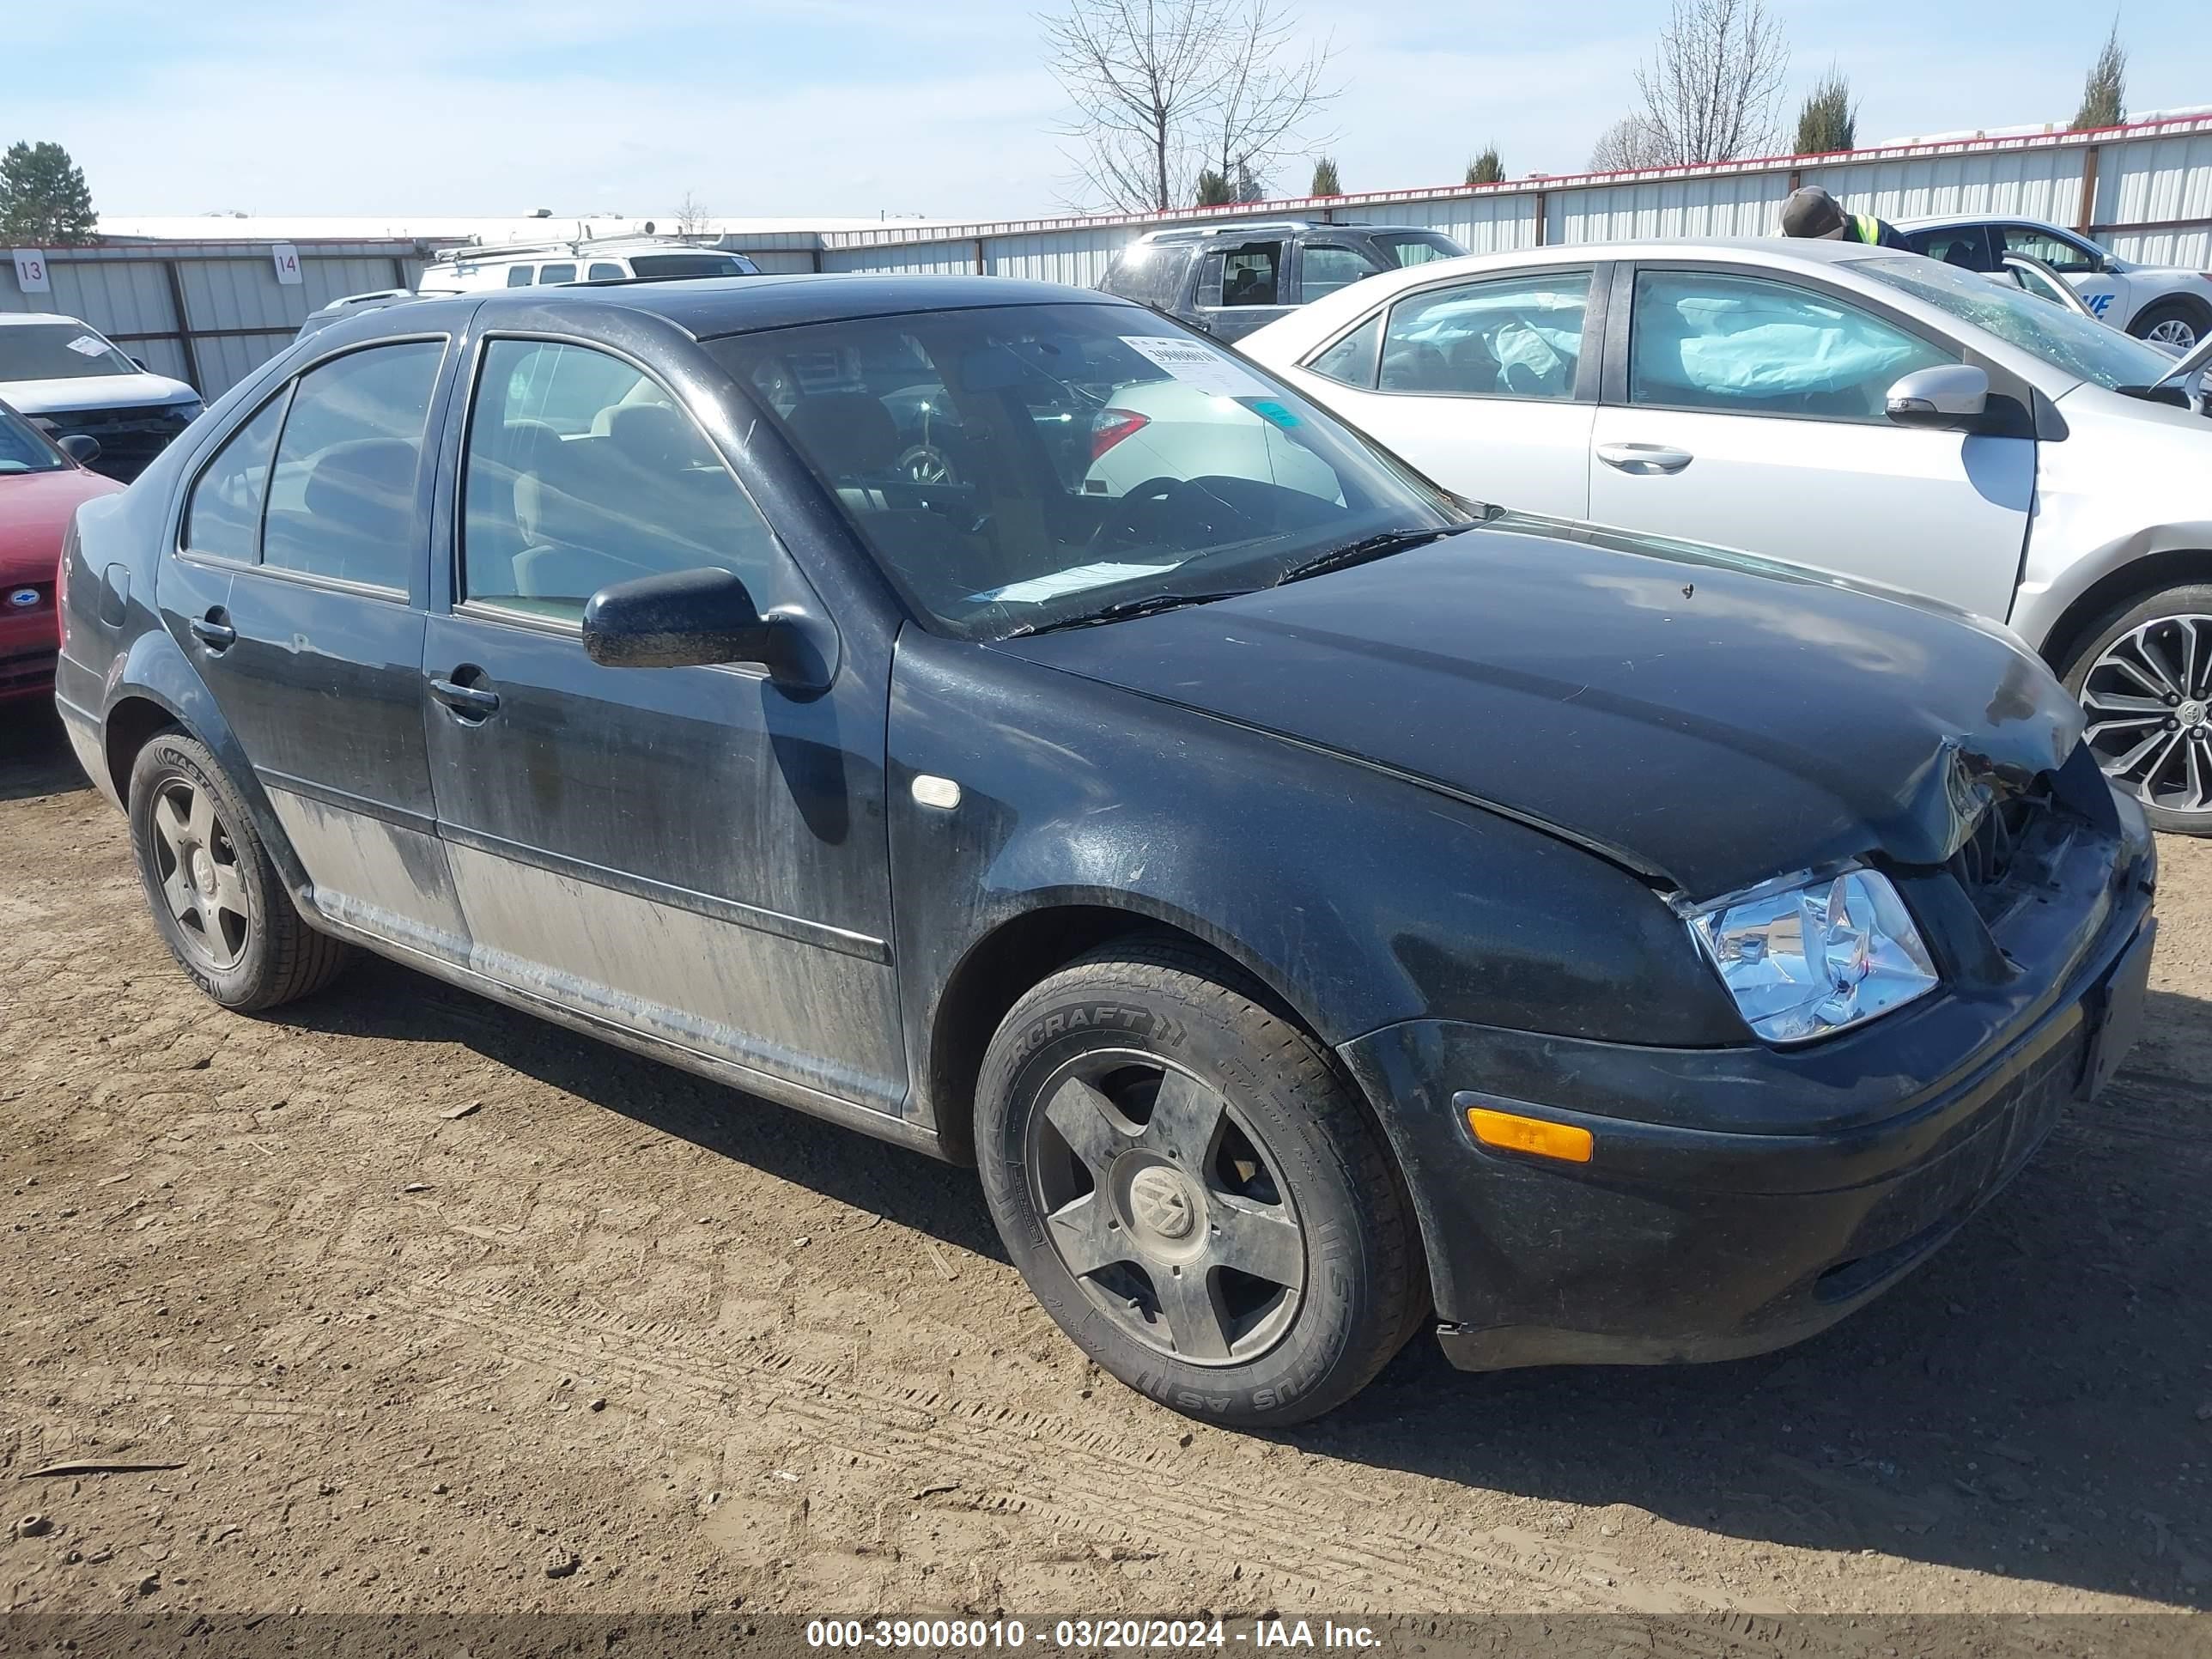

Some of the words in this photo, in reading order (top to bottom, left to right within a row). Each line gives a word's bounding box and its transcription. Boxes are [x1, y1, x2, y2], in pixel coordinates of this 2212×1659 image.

[21, 261, 42, 281] 13
[278, 255, 296, 273] 14
[1147, 349, 1219, 362] 39008010
[1176, 1391, 1232, 1413] AS
